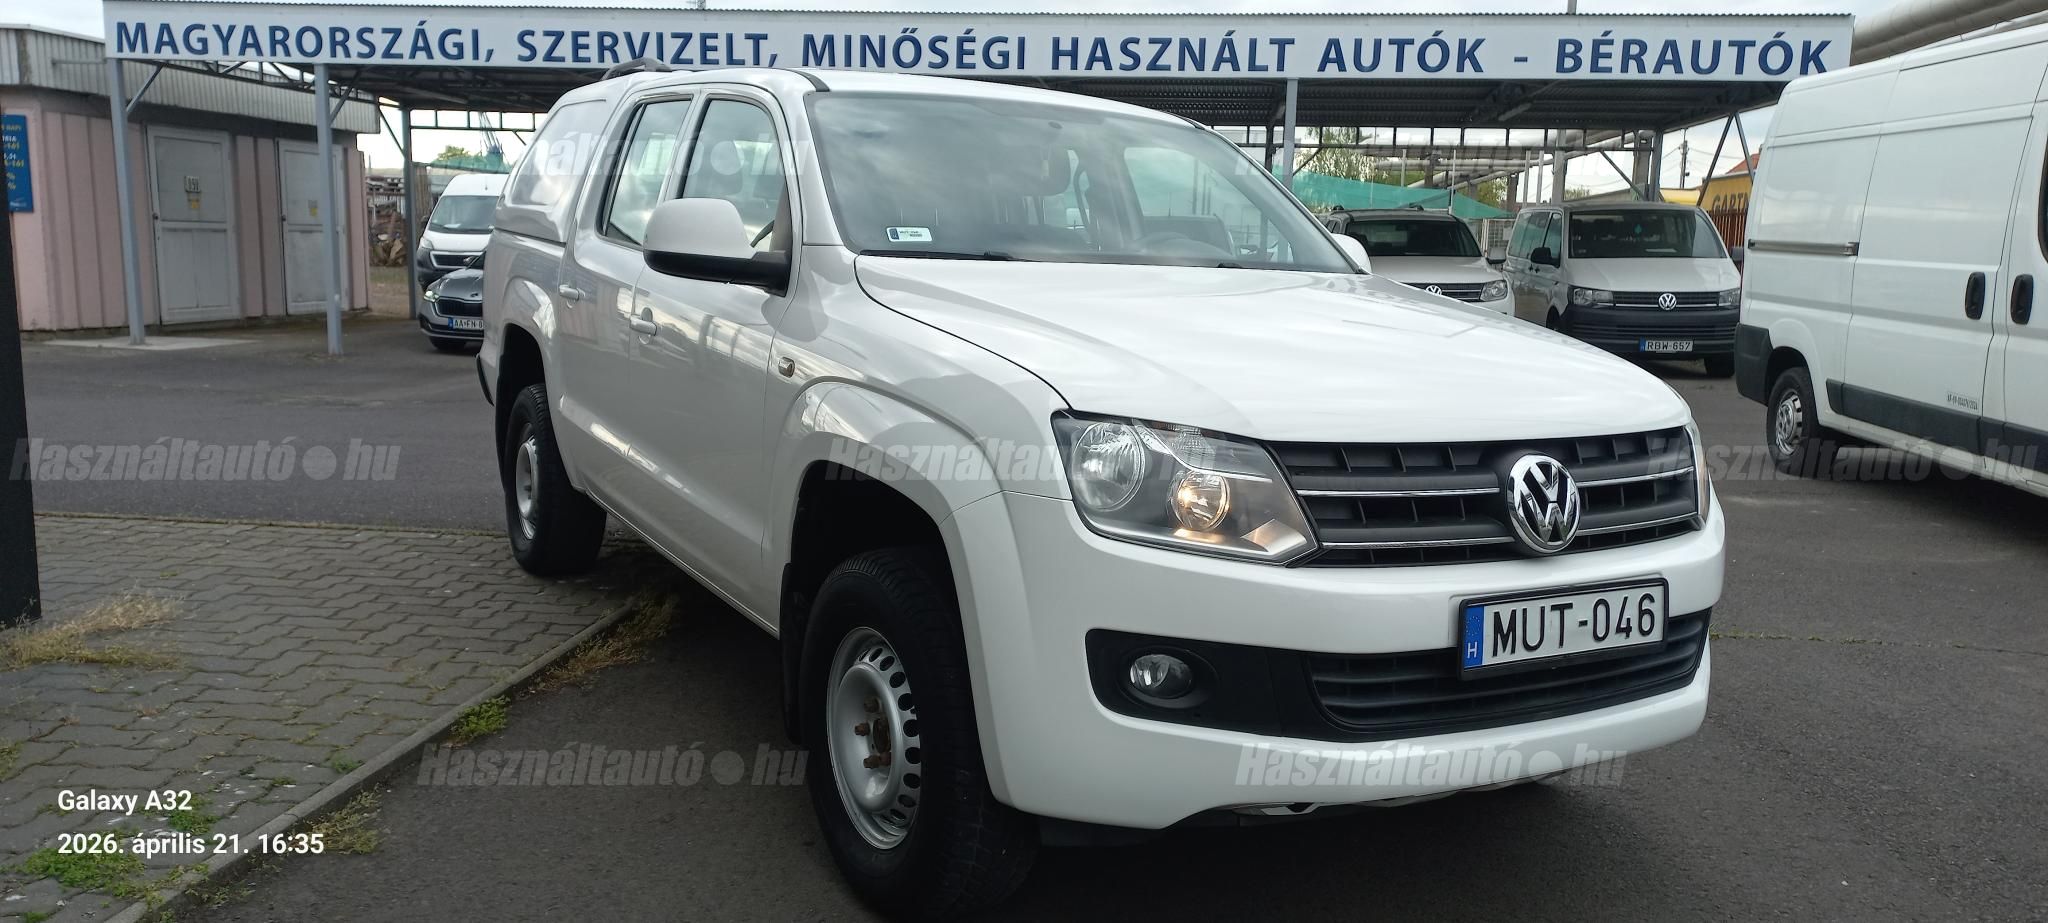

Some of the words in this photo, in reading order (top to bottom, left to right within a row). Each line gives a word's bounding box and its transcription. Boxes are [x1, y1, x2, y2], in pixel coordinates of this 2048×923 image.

[116, 20, 494, 63] MAGYARORSZÁGI,
[517, 29, 777, 67] SZERVIZELT,
[801, 27, 1026, 70] MINŐSÉGI
[1052, 29, 1295, 72] HASZNÁLT
[1317, 30, 1486, 73] AUTÓK
[1556, 30, 1833, 76] BÉRAUTÓK
[1647, 341, 1691, 352] RBW-657
[1492, 593, 1655, 658] MUT-046
[1467, 641, 1478, 659] H
